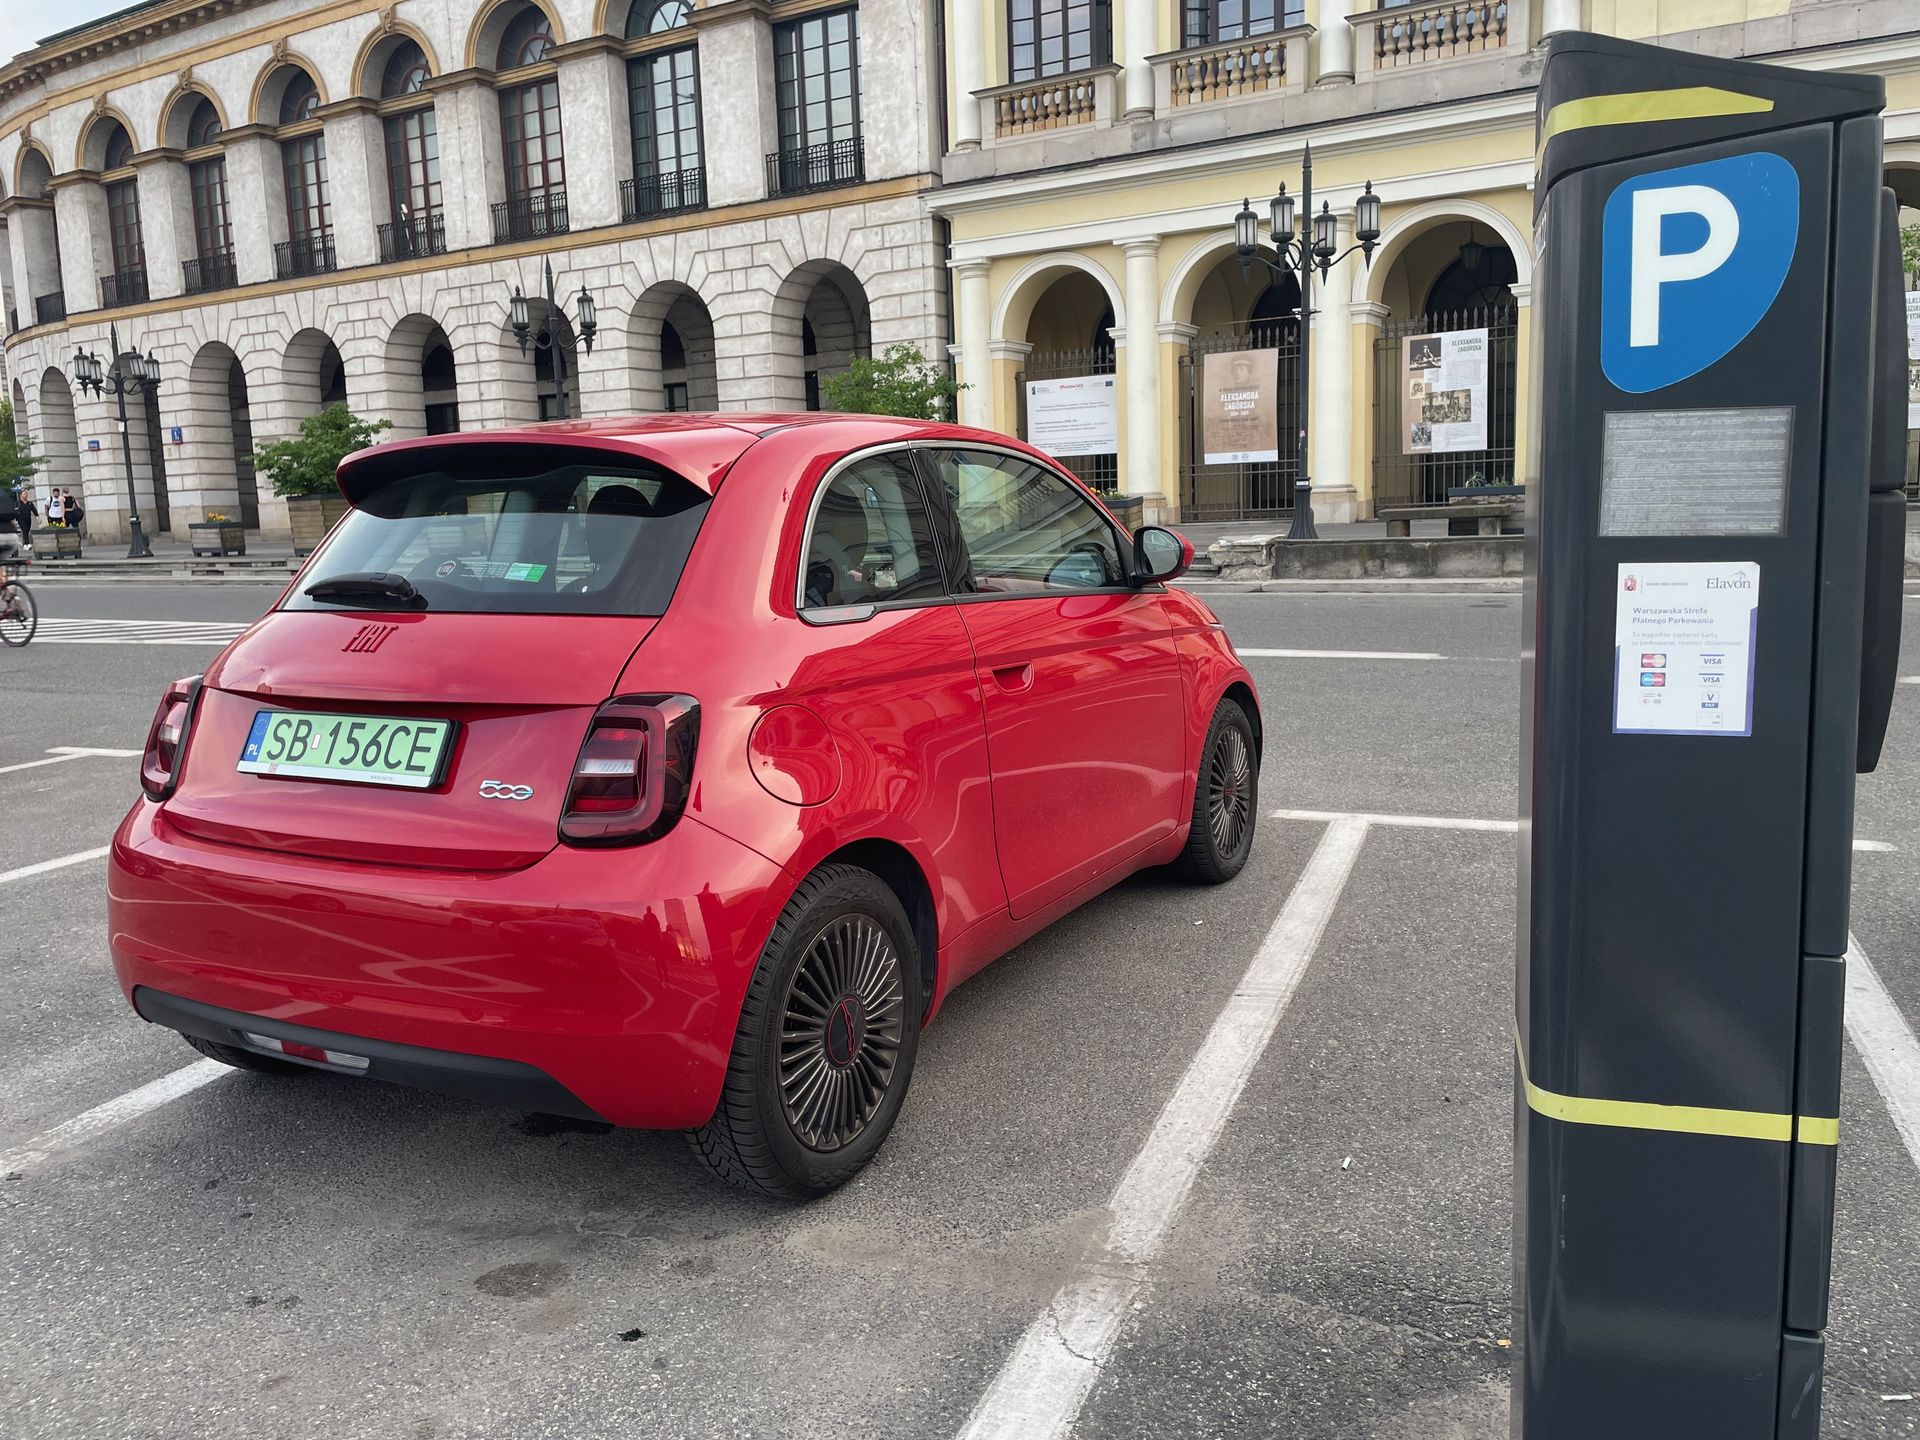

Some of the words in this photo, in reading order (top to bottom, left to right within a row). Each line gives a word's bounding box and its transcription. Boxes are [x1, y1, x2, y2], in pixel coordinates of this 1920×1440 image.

[1630, 185, 1740, 347] P
[1452, 337, 1482, 346] ALEKSANDRA
[1220, 391, 1259, 402] ALEKSANDRA
[1706, 576, 1751, 589] Elavon
[1632, 617, 1666, 625] Płatnego
[341, 624, 399, 653] FIAT
[246, 743, 259, 756] PL
[266, 718, 313, 762] SB
[325, 721, 438, 773] 156CE
